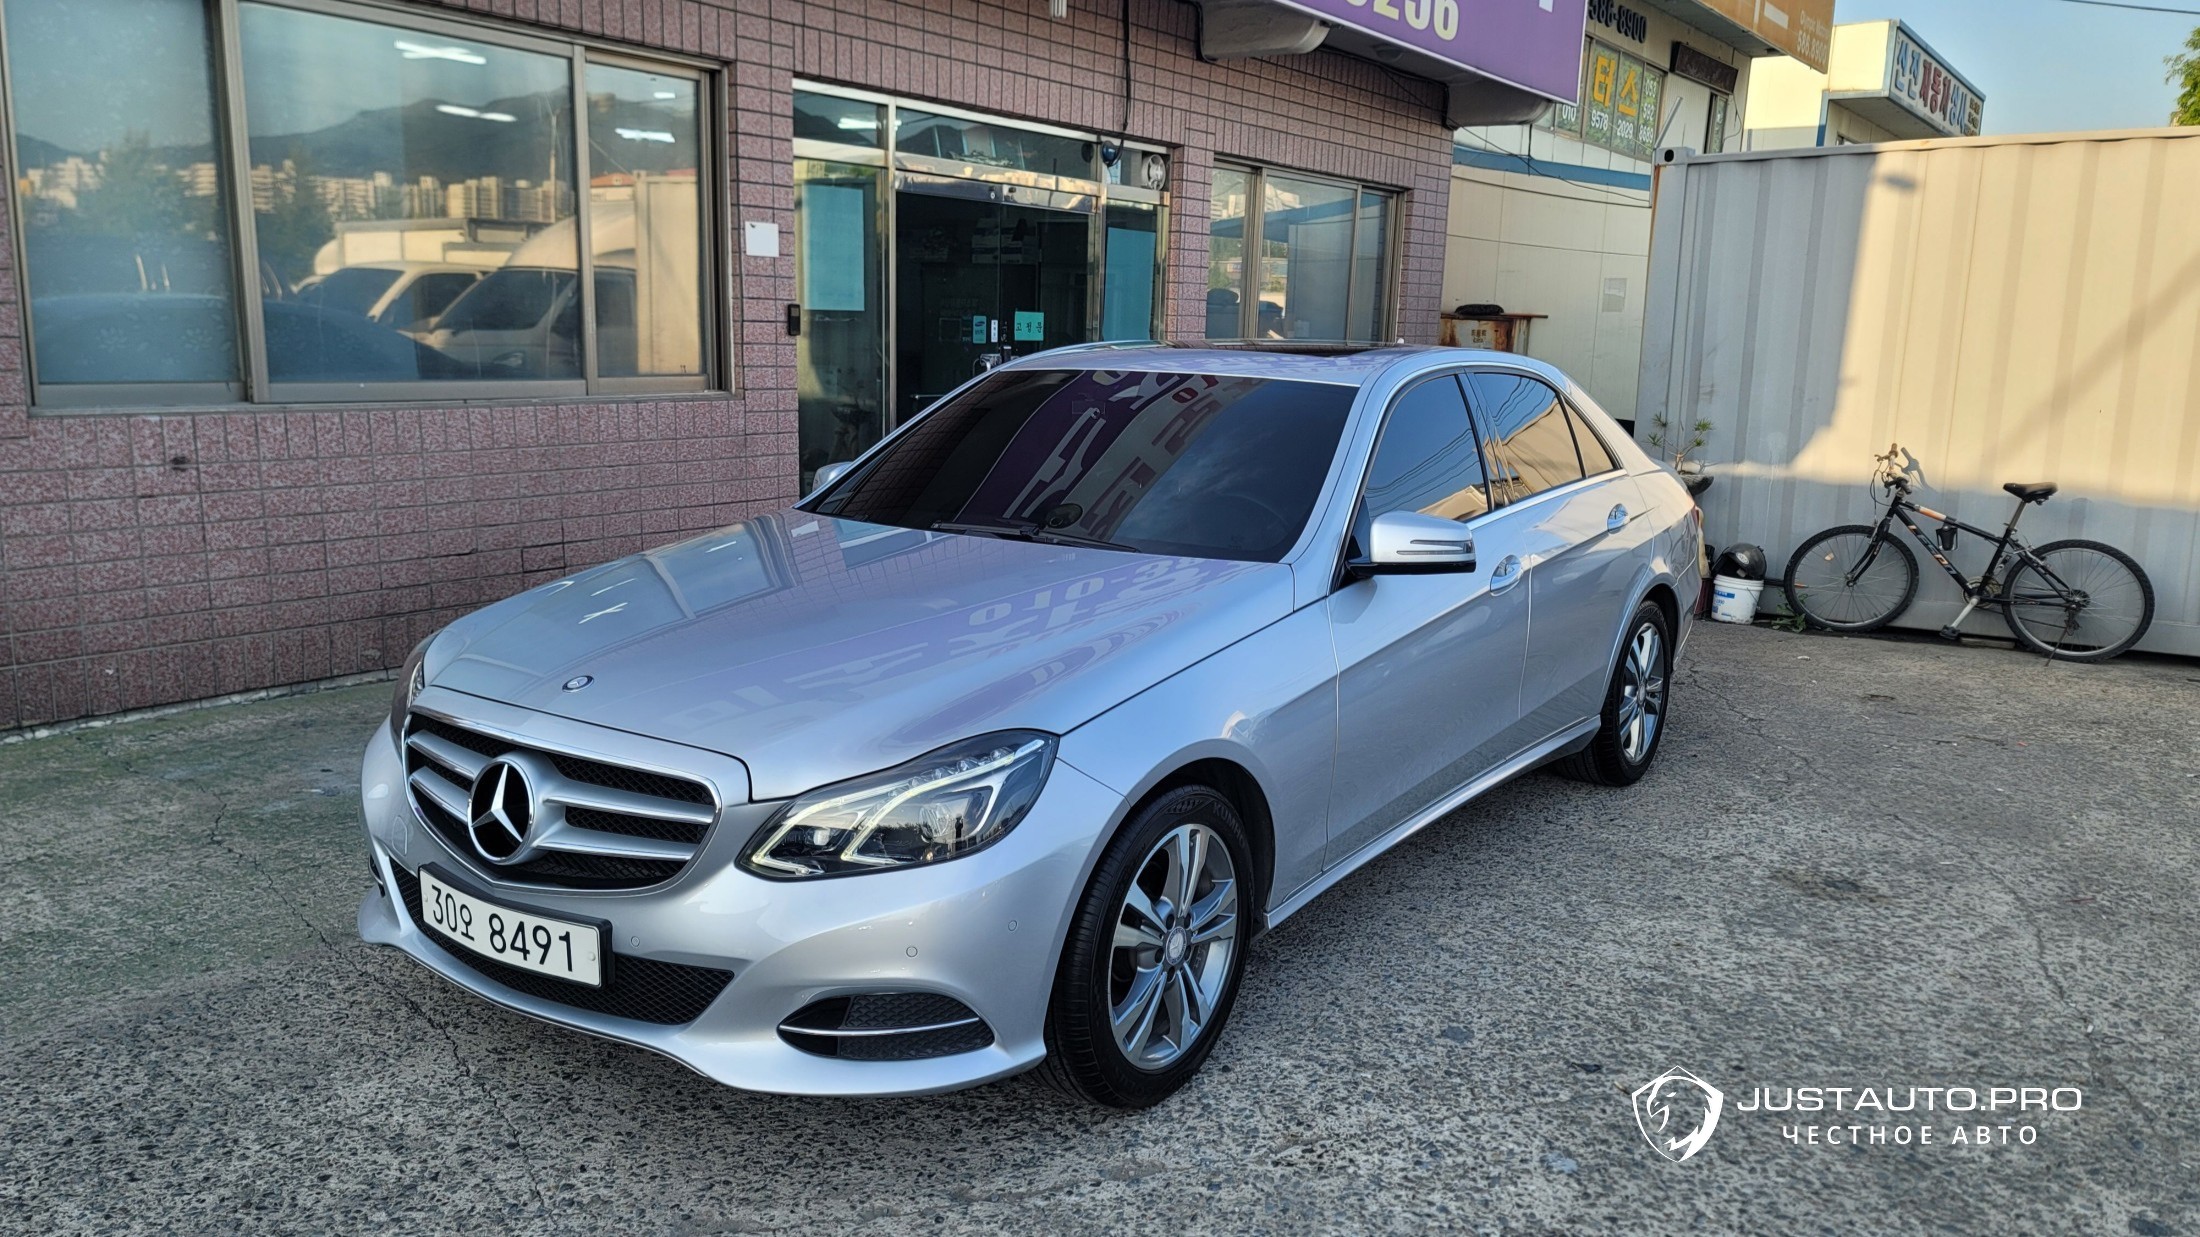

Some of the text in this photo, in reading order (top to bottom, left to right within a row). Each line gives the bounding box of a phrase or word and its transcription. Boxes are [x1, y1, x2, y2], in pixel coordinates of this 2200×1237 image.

[1562, 104, 1577, 122] 010
[1591, 109, 1609, 131] 9578
[1212, 802, 1246, 849] KUMHO
[431, 884, 573, 972] 30오 8491
